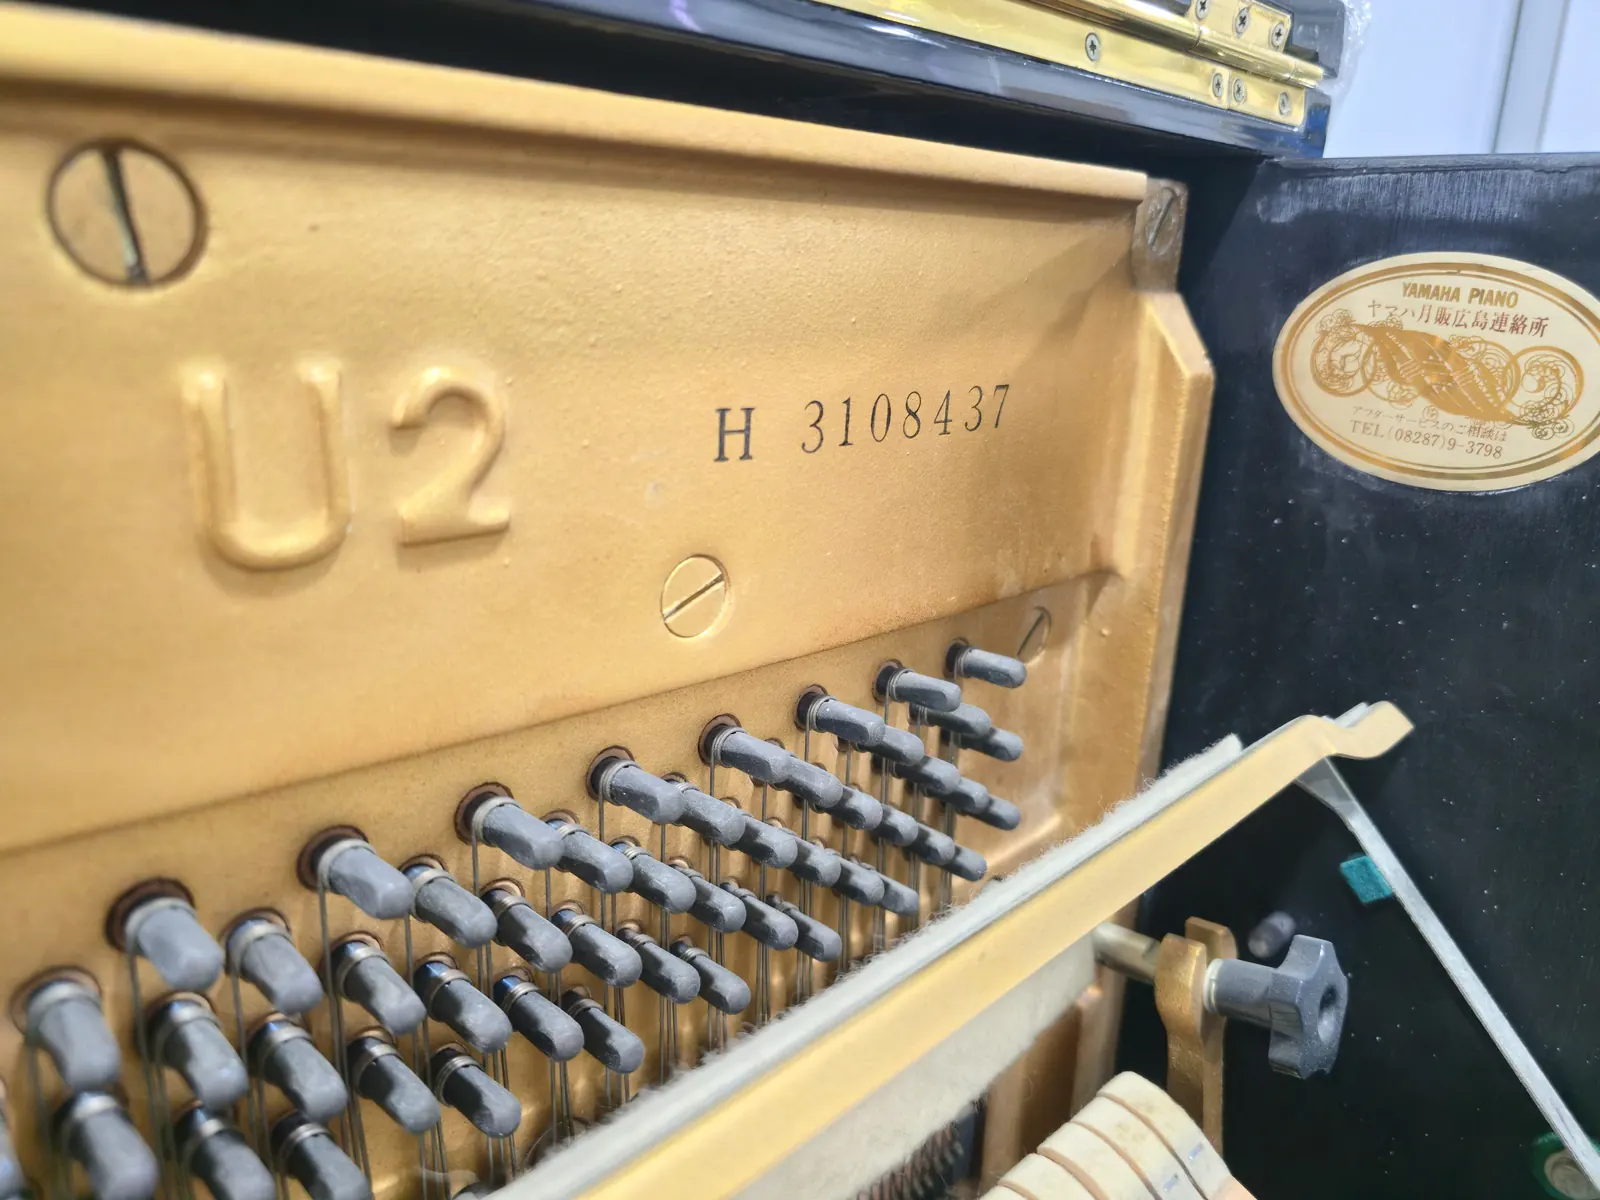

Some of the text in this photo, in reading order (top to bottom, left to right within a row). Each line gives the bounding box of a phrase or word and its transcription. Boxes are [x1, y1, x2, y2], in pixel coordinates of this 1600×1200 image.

[1368, 300, 1550, 338] ヤマハ月販広島連絡所
[1402, 282, 1519, 308] YAMAHA PIANO
[713, 384, 1010, 462] H 3108437
[178, 358, 511, 572] U2
